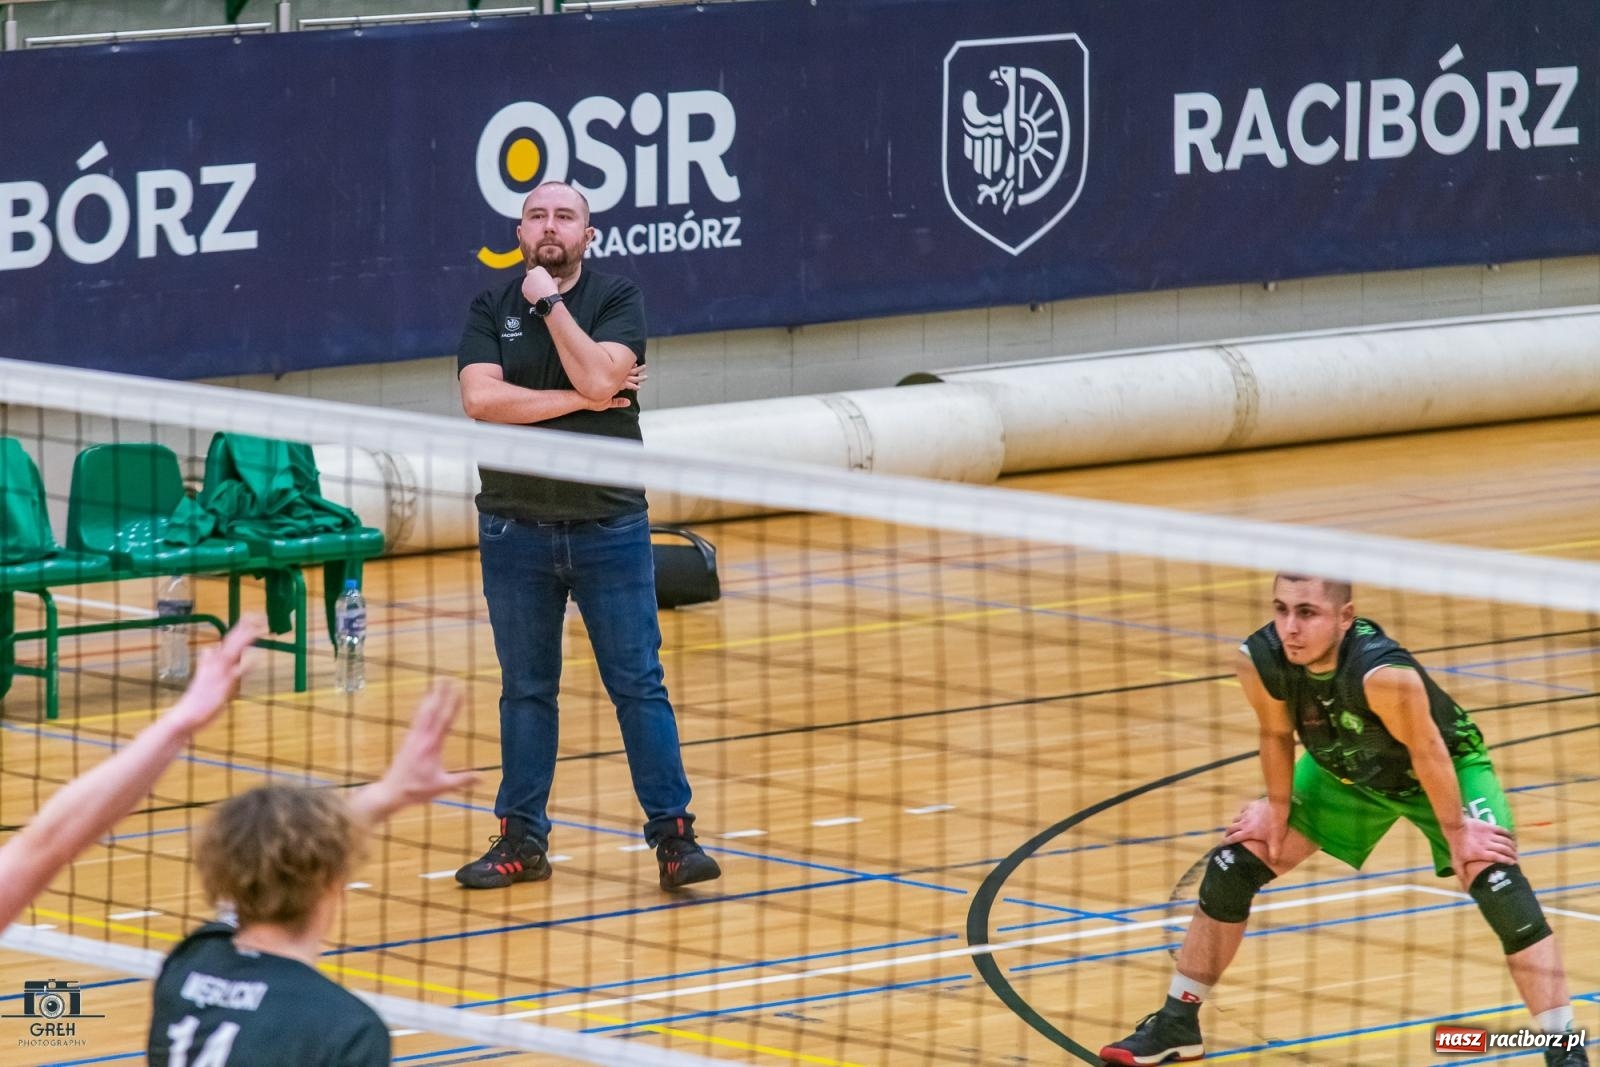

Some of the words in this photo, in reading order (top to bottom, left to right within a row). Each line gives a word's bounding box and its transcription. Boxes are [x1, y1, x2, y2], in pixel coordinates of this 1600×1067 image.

[1173, 44, 1580, 175] RACIBÓRZ
[0, 140, 258, 270] BÓRZ
[583, 210, 742, 259] RACIBÓRZ
